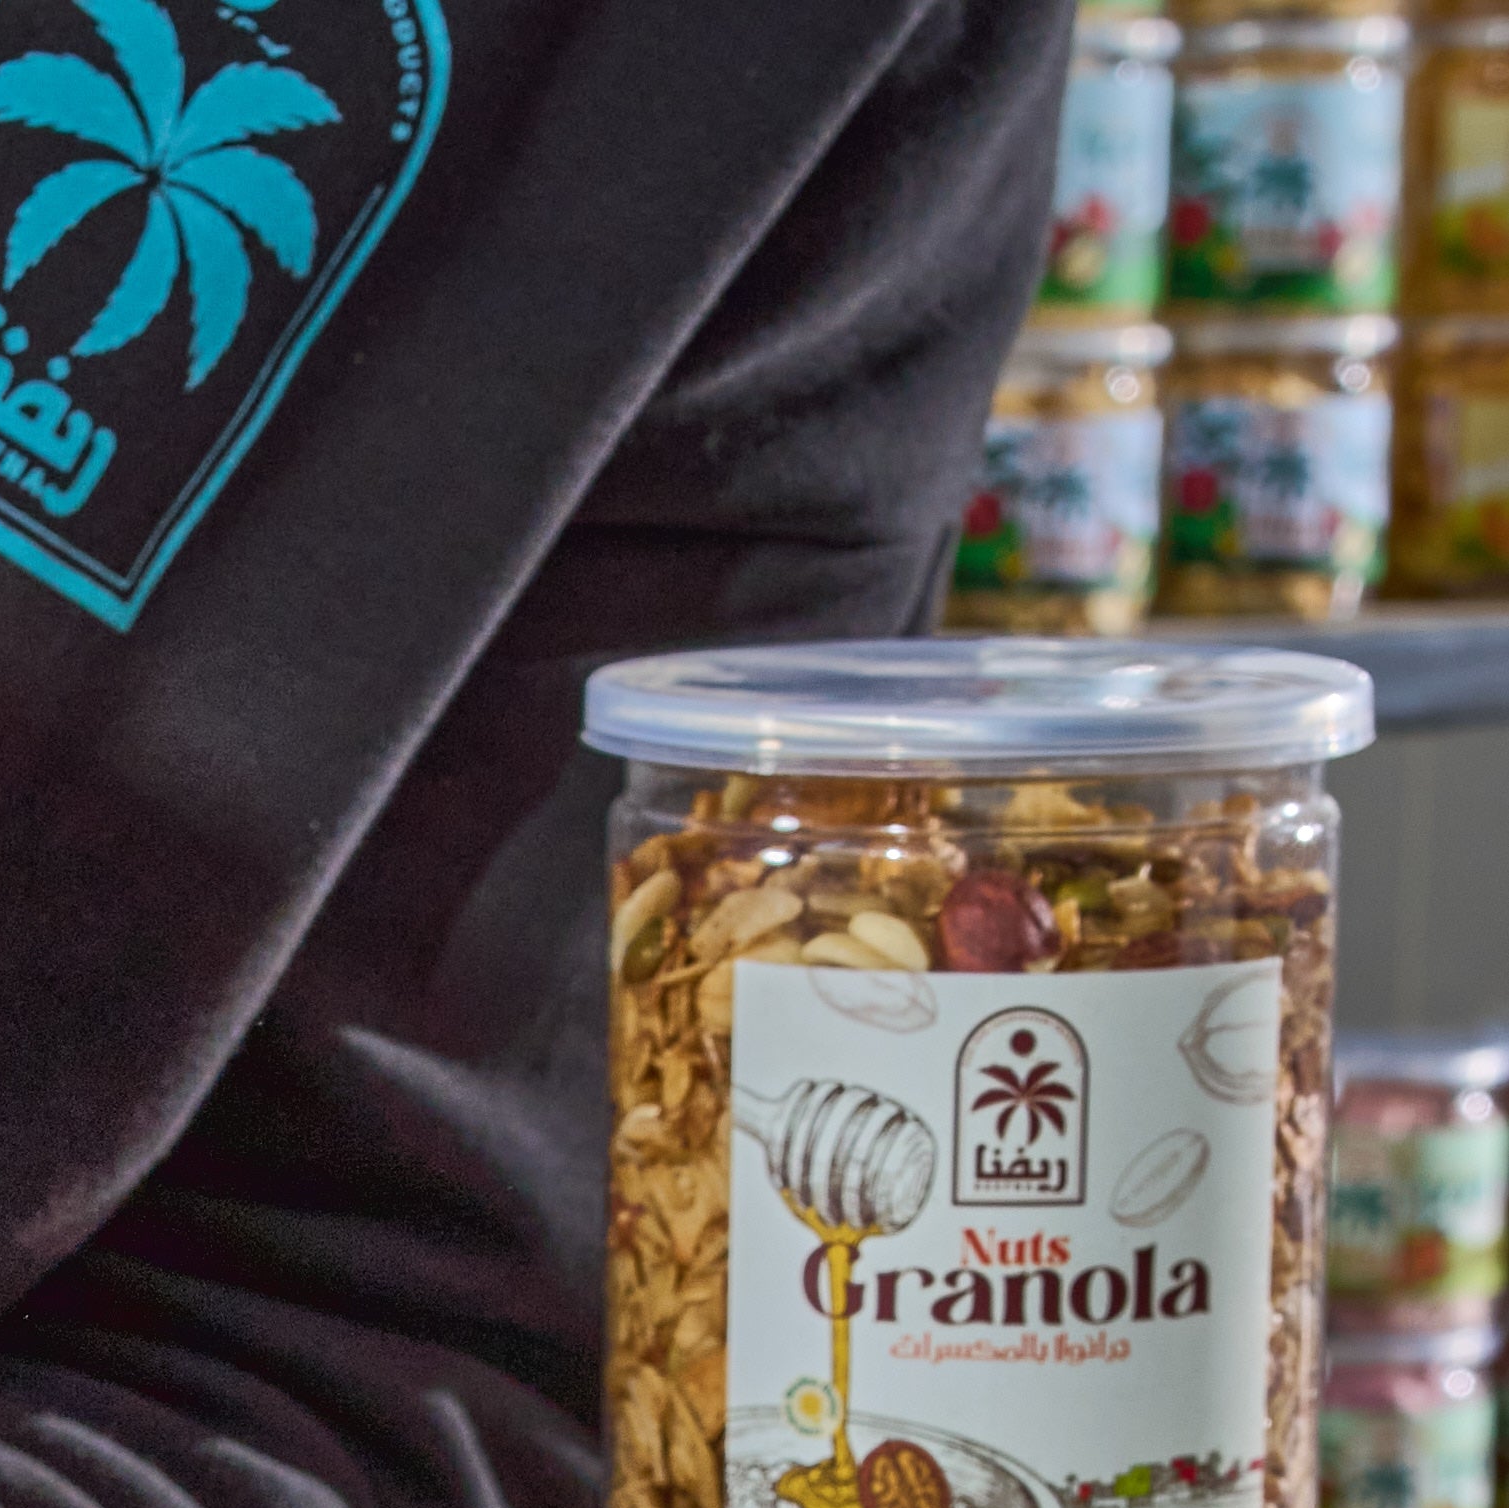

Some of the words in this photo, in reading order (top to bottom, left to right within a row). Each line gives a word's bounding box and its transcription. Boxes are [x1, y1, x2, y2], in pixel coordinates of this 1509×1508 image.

[974, 1144, 1068, 1193] ريفنا
[960, 1228, 1072, 1268] Nuts
[802, 1241, 1212, 1327] Granola
